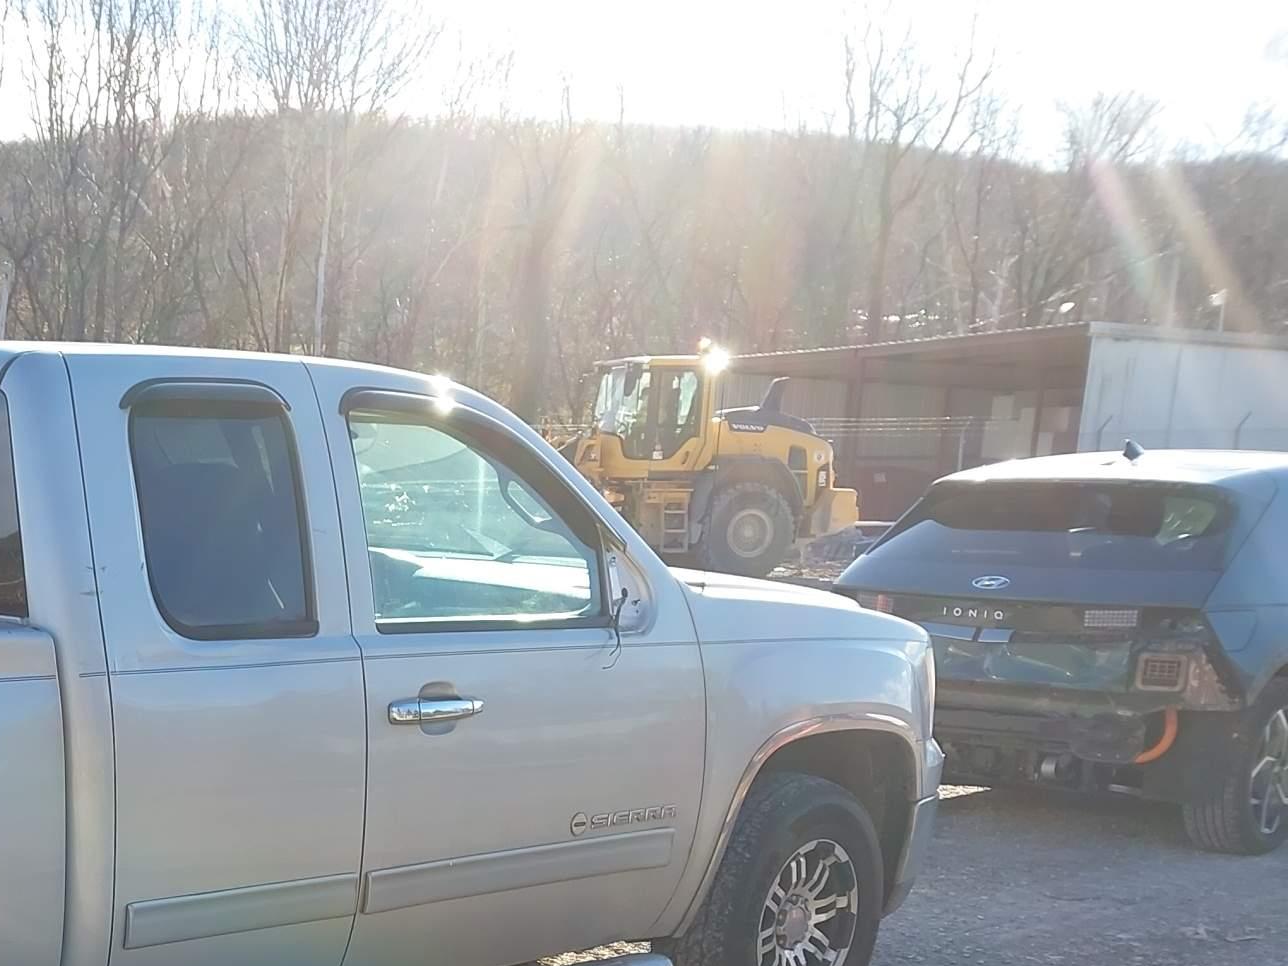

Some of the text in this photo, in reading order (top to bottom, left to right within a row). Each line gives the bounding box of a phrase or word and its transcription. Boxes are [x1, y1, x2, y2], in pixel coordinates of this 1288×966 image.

[731, 423, 764, 431] VOLVO
[943, 606, 1004, 620] IONIQ
[591, 803, 678, 829] SIERRA
